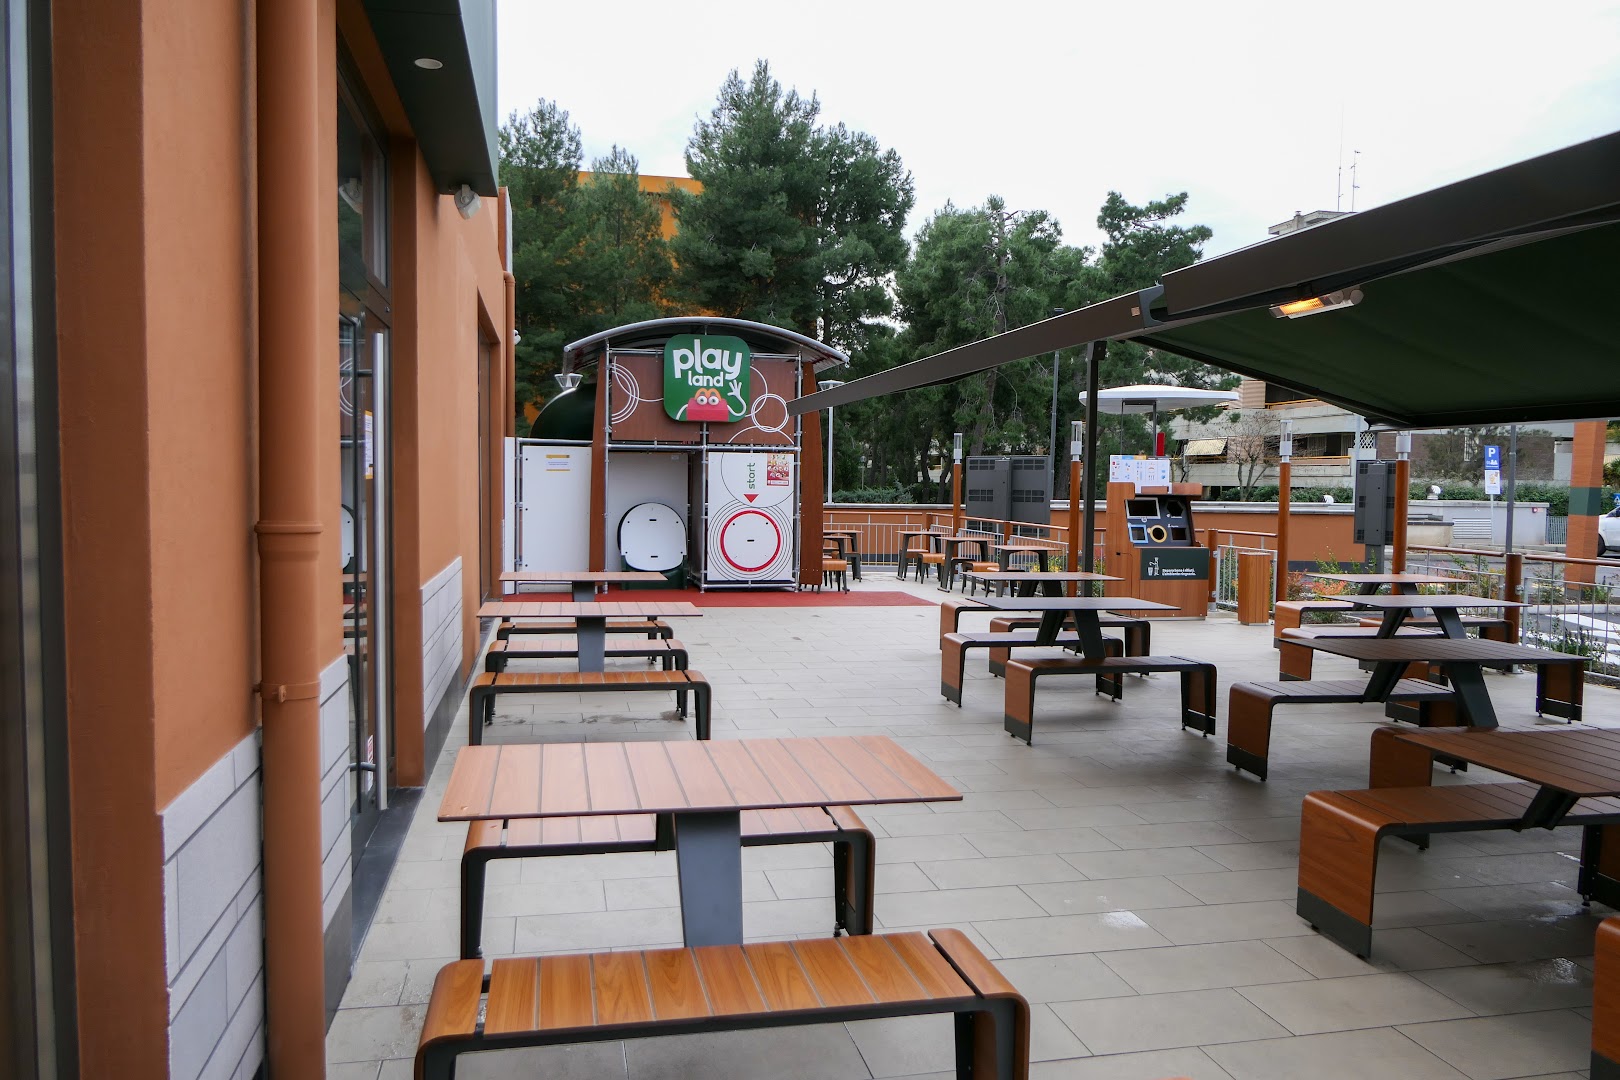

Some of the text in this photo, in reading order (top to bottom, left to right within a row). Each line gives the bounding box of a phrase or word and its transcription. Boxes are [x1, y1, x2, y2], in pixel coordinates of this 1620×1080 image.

[673, 339, 742, 380] play
[688, 370, 724, 387] land
[1488, 448, 1496, 458] P
[747, 462, 756, 490] start
